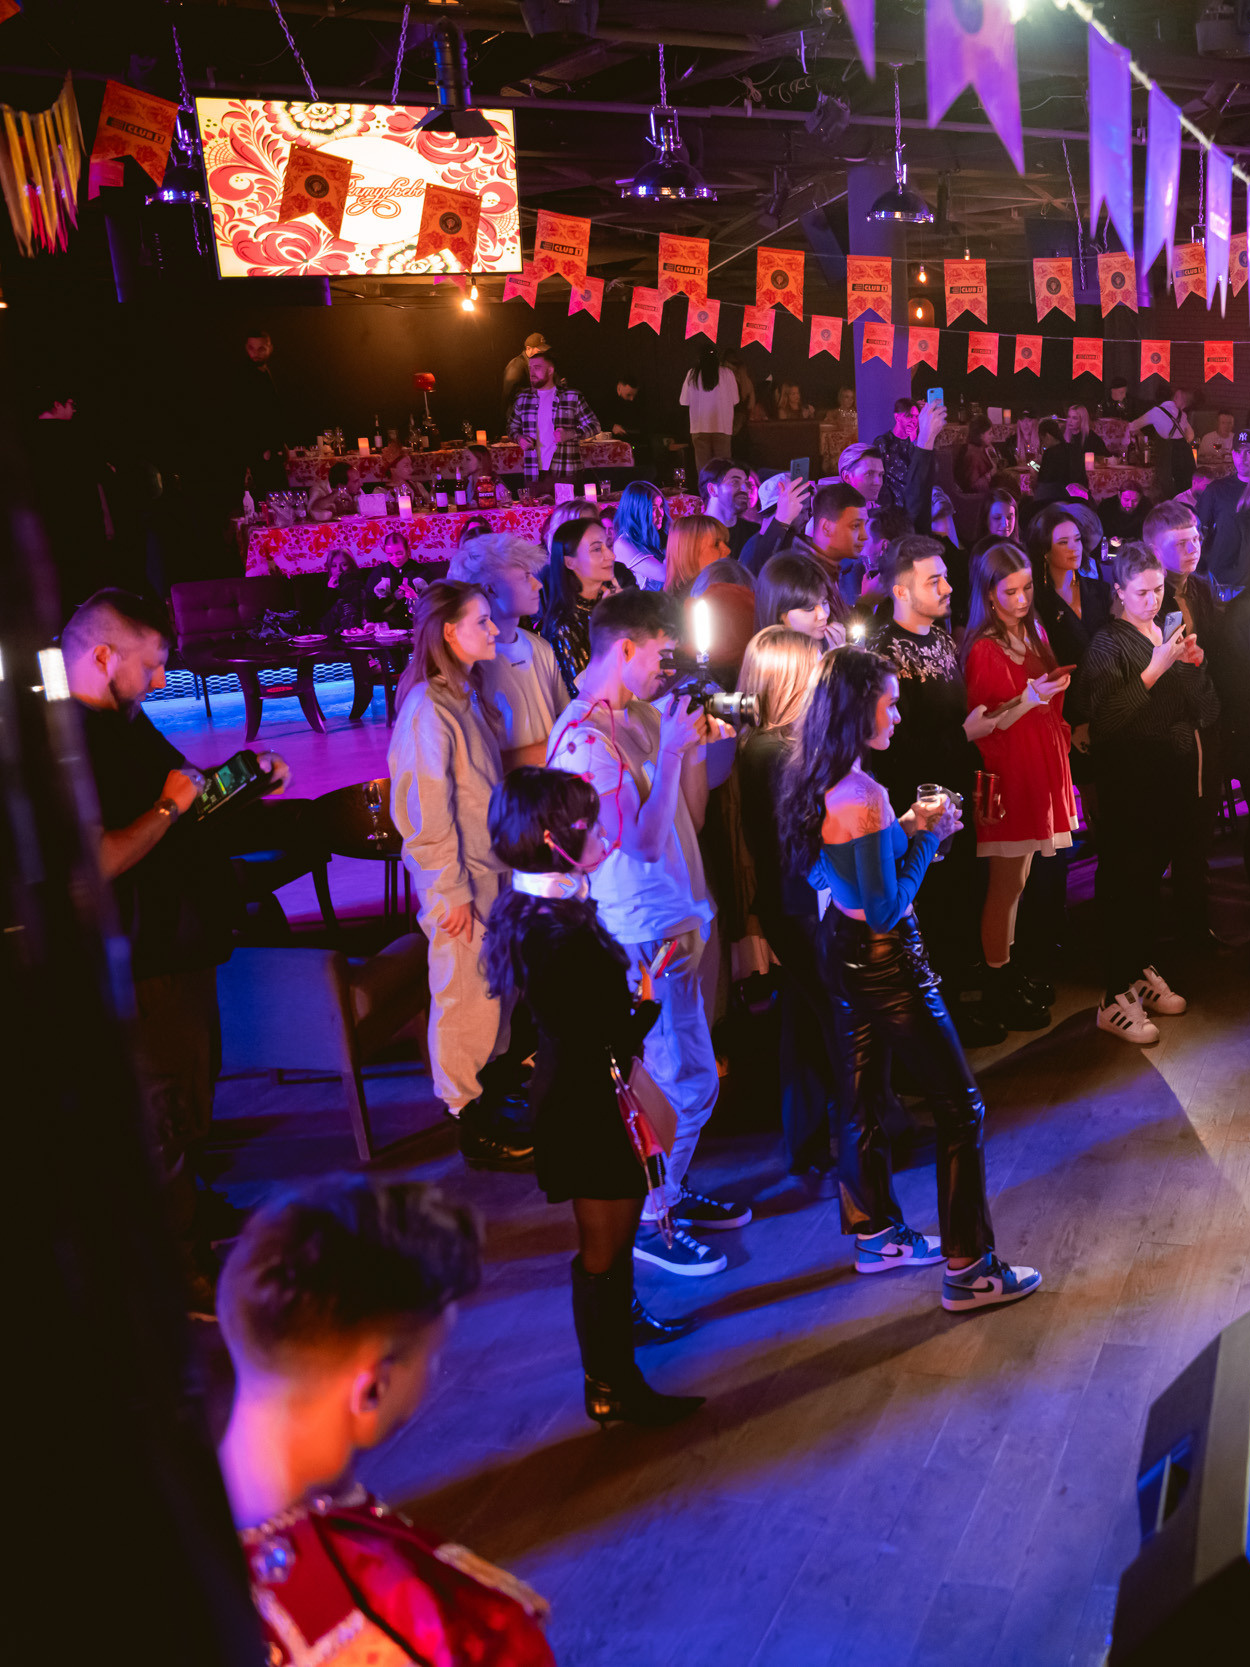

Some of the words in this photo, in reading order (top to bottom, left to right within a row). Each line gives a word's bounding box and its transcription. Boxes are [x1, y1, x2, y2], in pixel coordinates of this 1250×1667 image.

[127, 124, 154, 140] CLUB
[554, 244, 575, 254] CLUB
[676, 265, 695, 274] CLUB
[1184, 268, 1198, 276] CLUB
[1239, 432, 1248, 441] NY
